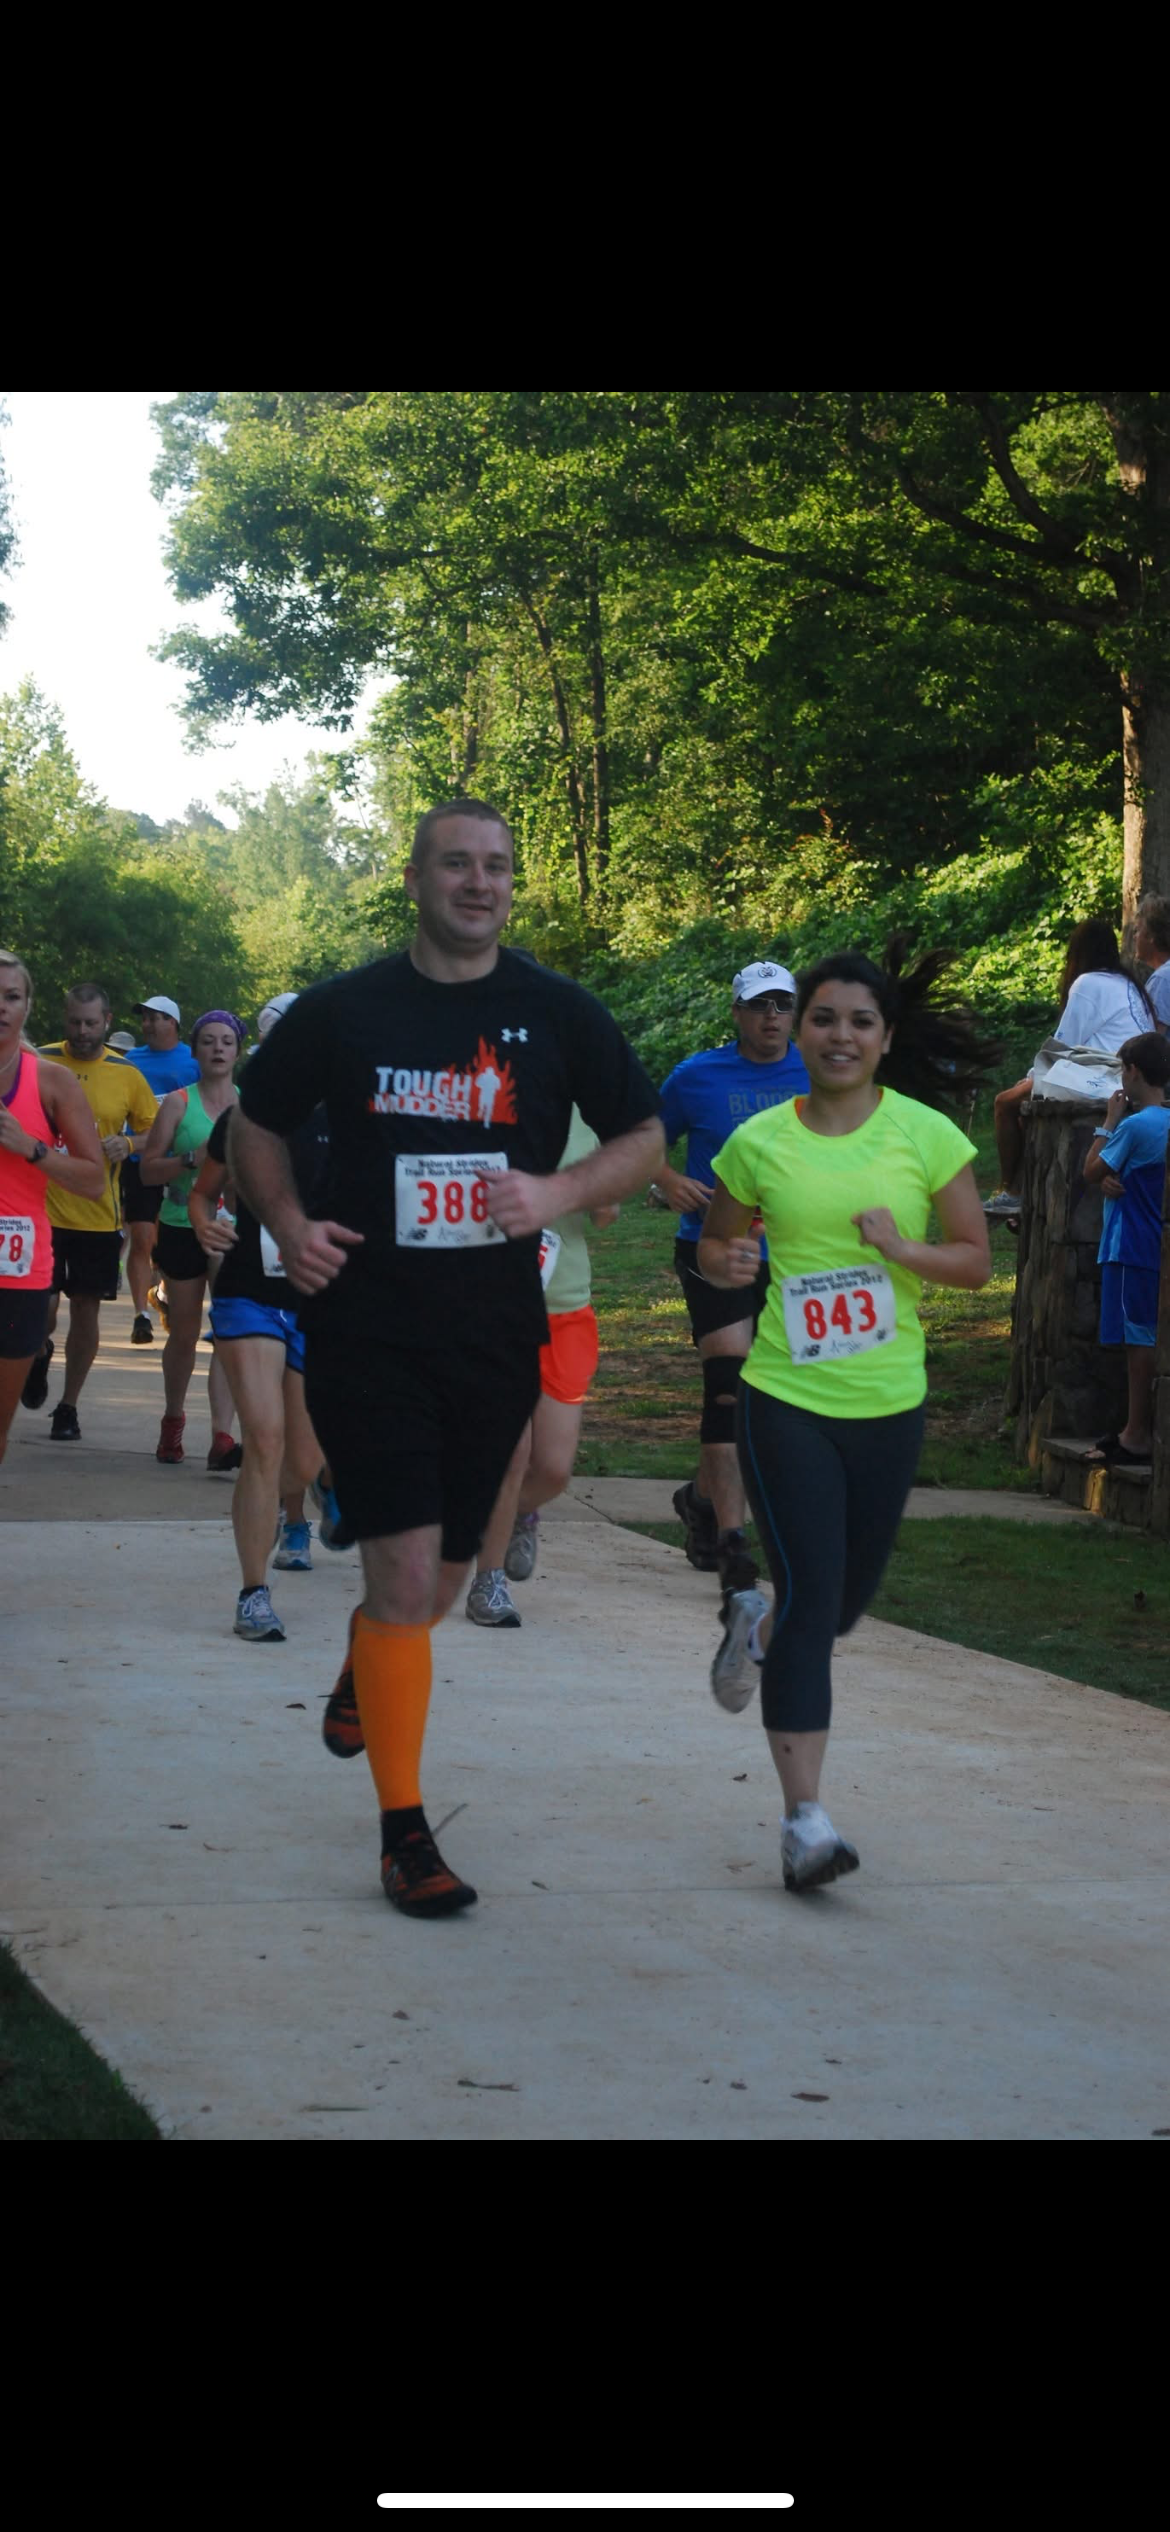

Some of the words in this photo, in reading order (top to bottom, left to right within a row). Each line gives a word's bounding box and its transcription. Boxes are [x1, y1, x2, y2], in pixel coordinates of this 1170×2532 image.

[375, 1066, 472, 1102] TOUGH
[373, 1094, 471, 1121] MUDDER
[417, 1180, 490, 1226] 388
[811, 1284, 828, 1294] Run
[831, 1280, 858, 1291] Series
[861, 1274, 883, 1286] 2012
[803, 1289, 877, 1341] 843
